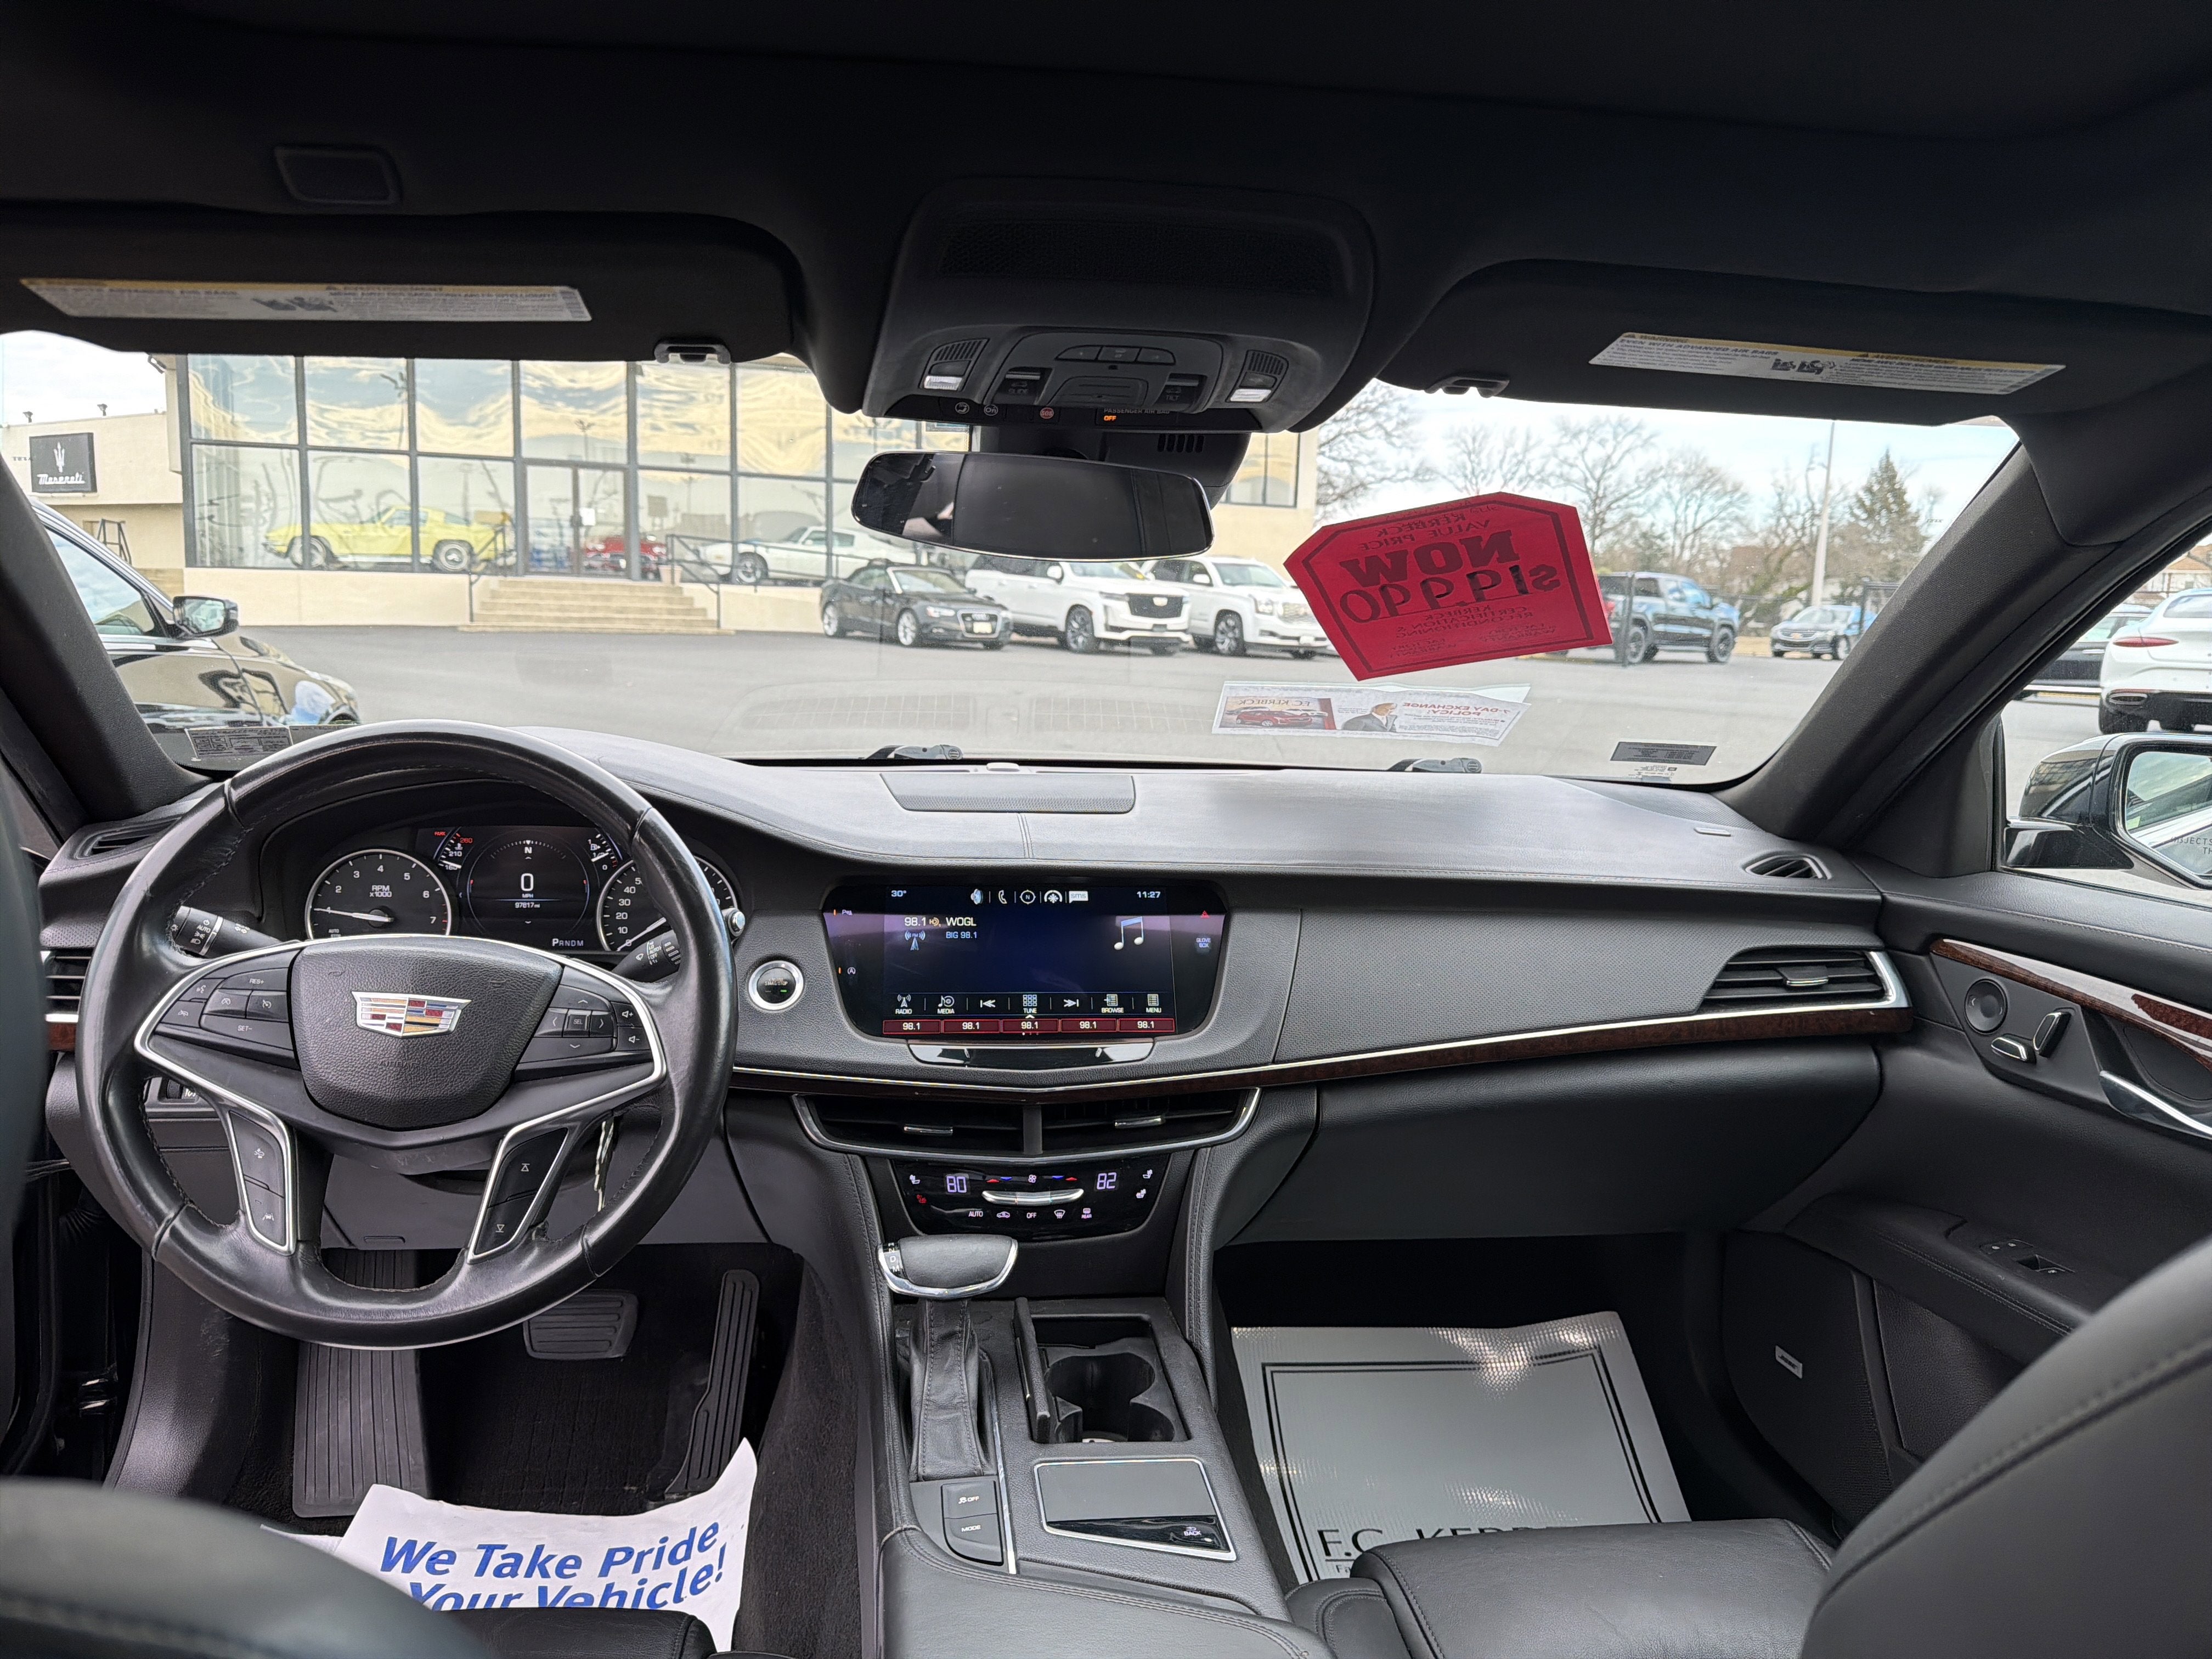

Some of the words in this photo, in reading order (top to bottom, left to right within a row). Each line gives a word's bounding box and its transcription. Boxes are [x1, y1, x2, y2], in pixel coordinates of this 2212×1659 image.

[37, 472, 86, 485] Maserati
[521, 873, 534, 891] 0
[335, 885, 342, 893] 2
[904, 917, 927, 927] 98.1
[946, 917, 977, 927] WOGL
[196, 924, 212, 933] AUTO
[902, 1022, 921, 1030] 98.1
[962, 1022, 980, 1030] 98.1
[1021, 1021, 1039, 1030] 98.1
[1079, 1021, 1097, 1029] 98.1
[1137, 1020, 1154, 1029] 98.1
[946, 1175, 967, 1193] 80
[1097, 1172, 1118, 1190] 82
[892, 1265, 900, 1273] M
[380, 1536, 457, 1576] We
[474, 1544, 582, 1579] Take
[597, 1522, 719, 1578] Pride
[409, 1582, 524, 1612] Your
[537, 1542, 727, 1610] Vehicle!
